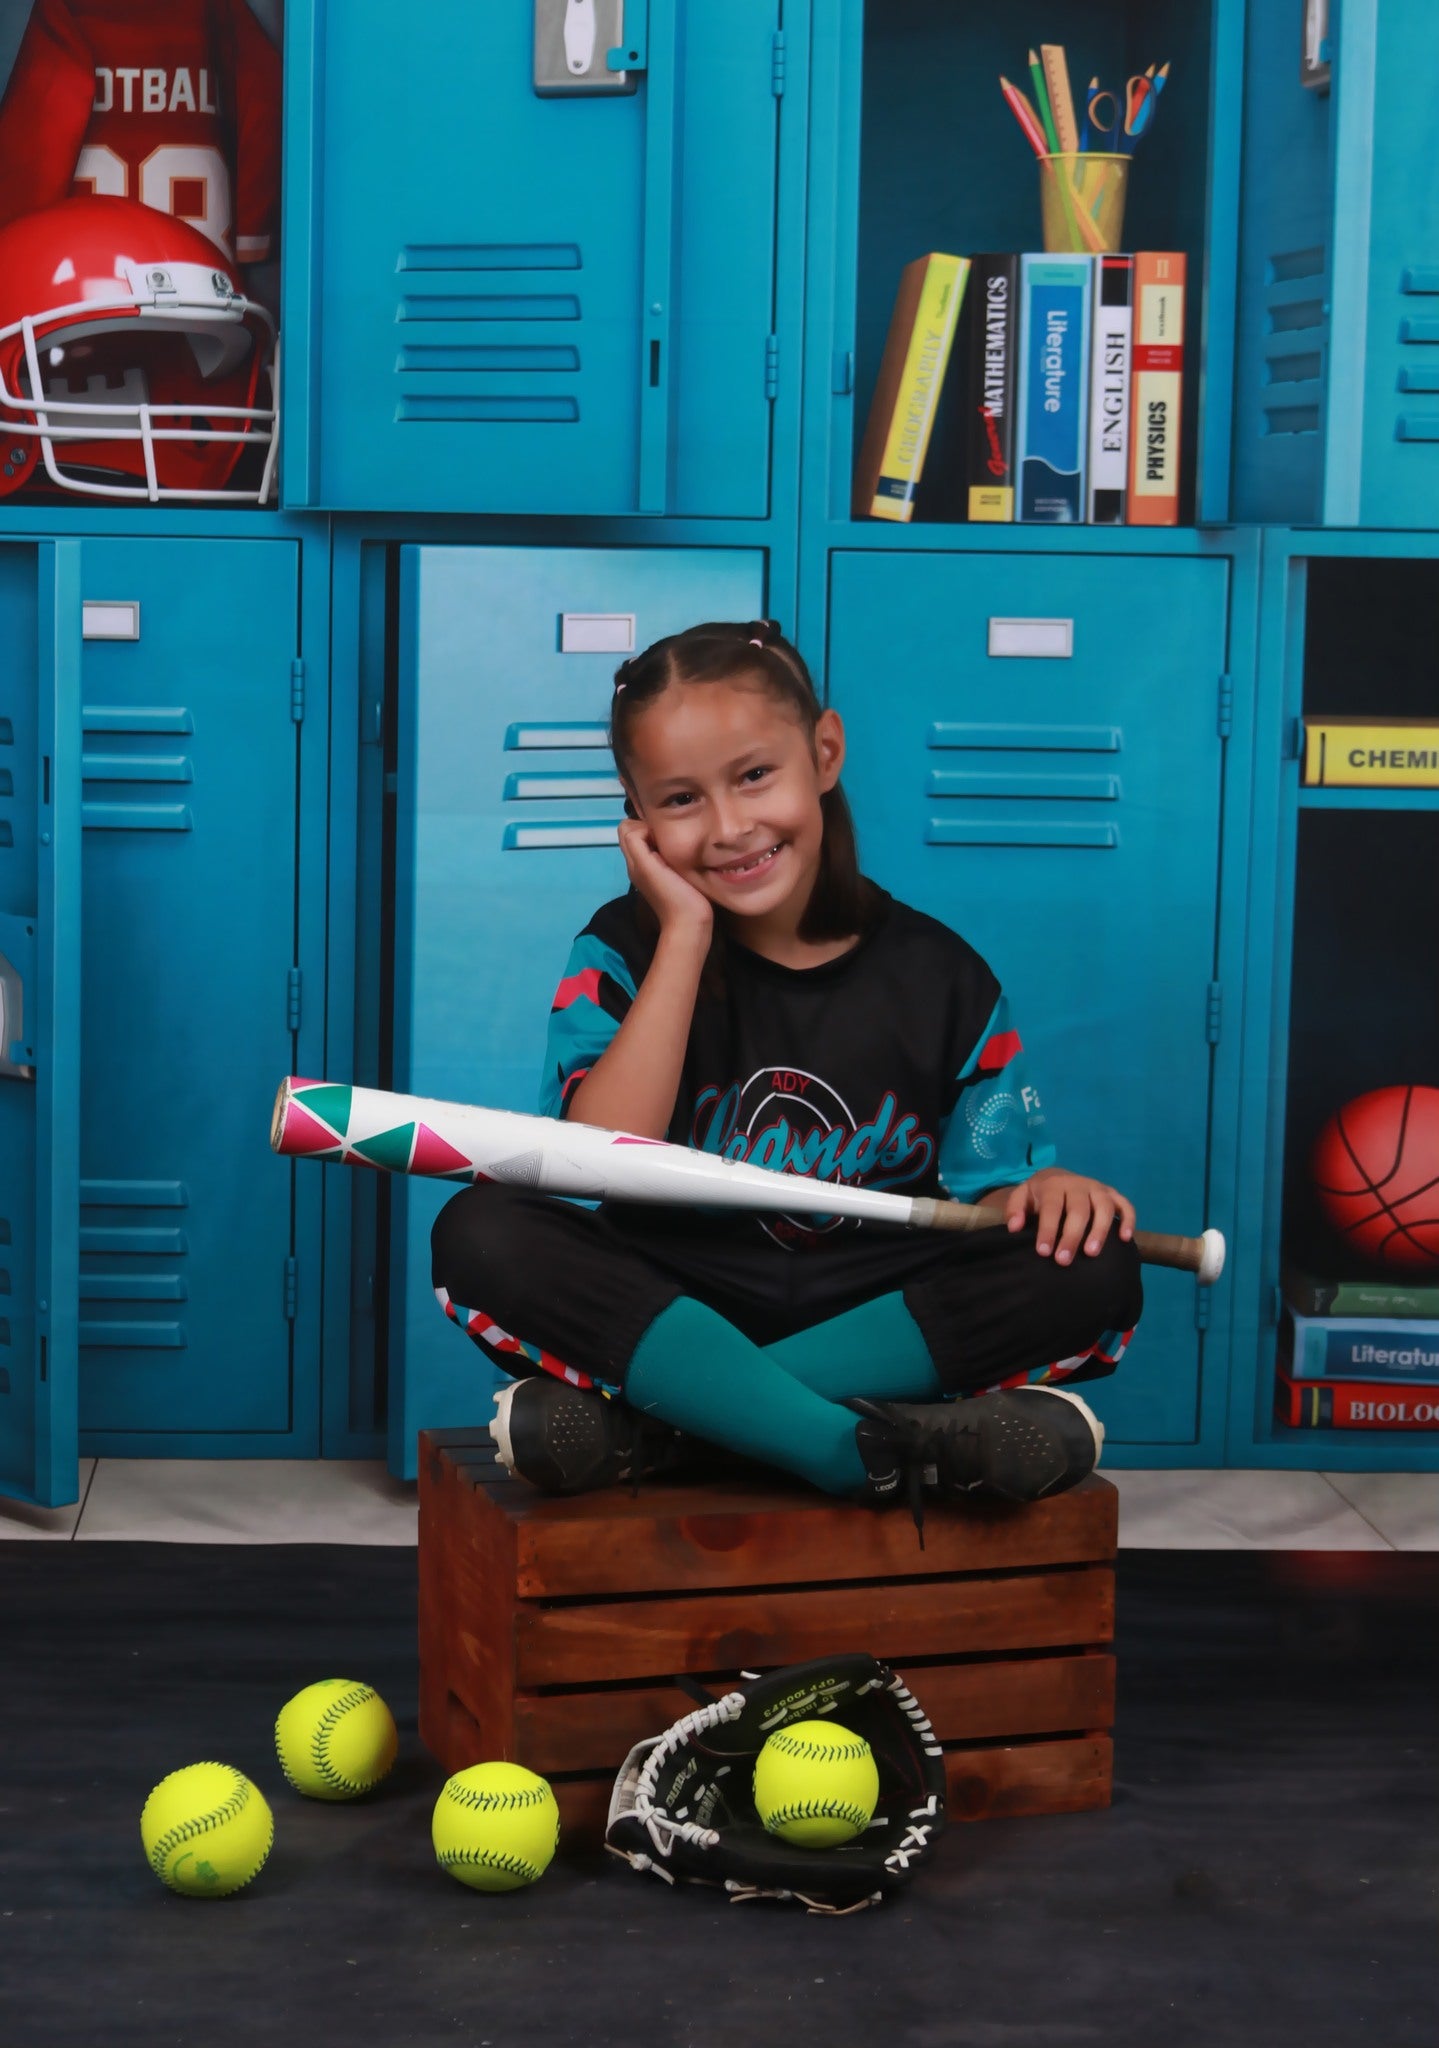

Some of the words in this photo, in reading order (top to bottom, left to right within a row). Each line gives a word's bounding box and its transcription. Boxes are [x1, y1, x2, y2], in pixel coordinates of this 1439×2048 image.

[984, 275, 1009, 418] MATHEMATICS
[1044, 310, 1068, 414] Literature
[1102, 332, 1126, 453] ENGLISH
[1146, 400, 1167, 481] PHYSICS
[1347, 748, 1438, 769] CHEMI
